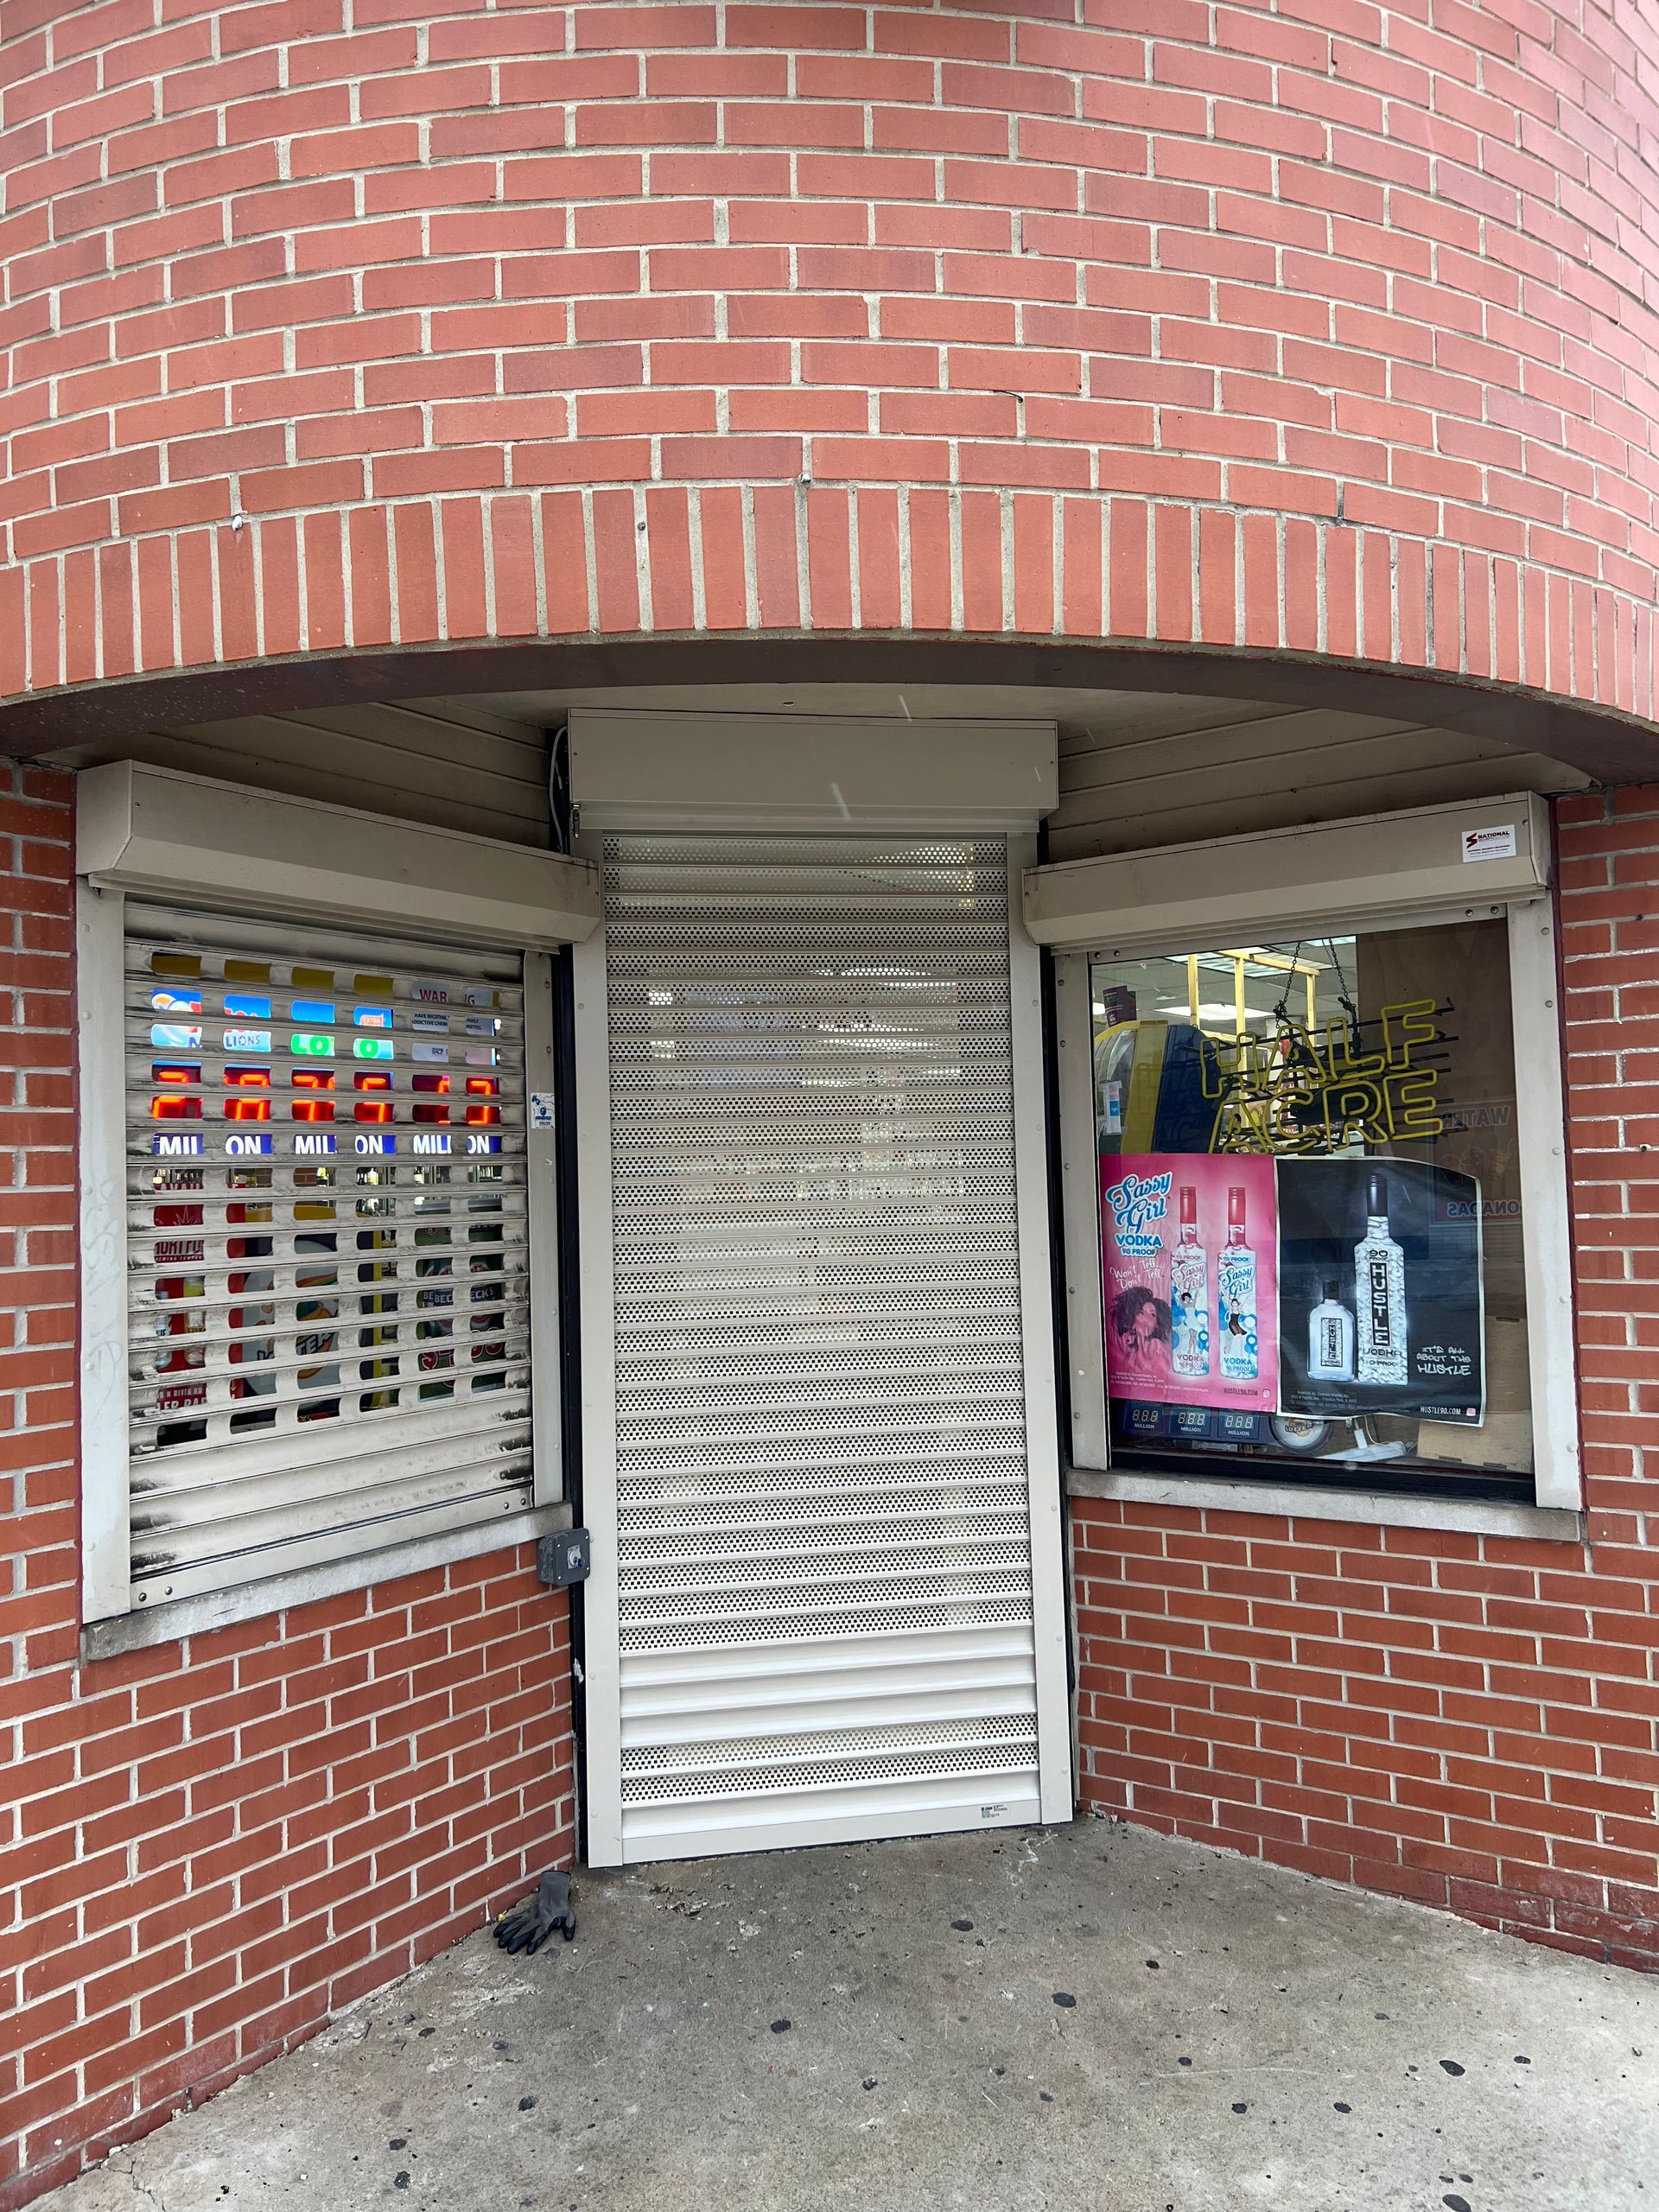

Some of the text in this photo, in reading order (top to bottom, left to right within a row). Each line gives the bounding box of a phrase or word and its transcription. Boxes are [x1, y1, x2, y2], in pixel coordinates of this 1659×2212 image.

[363, 1017, 381, 1026] EXTRA
[1200, 998, 1436, 1099] HALF
[1210, 1069, 1444, 1154] ACRE
[1106, 1171, 1173, 1211] Sassy
[1116, 1195, 1167, 1236] Girl
[1116, 1234, 1163, 1248] VODKA
[1219, 1266, 1253, 1286] Sassy
[1371, 1263, 1389, 1346] HUSTLE
[1416, 1353, 1446, 1362] ABOUT
[1417, 1363, 1471, 1376] HUSTLE
[1224, 1388, 1258, 1396] HUSTLE90.COM
[1420, 1406, 1461, 1415] HUSTLE90.COM
